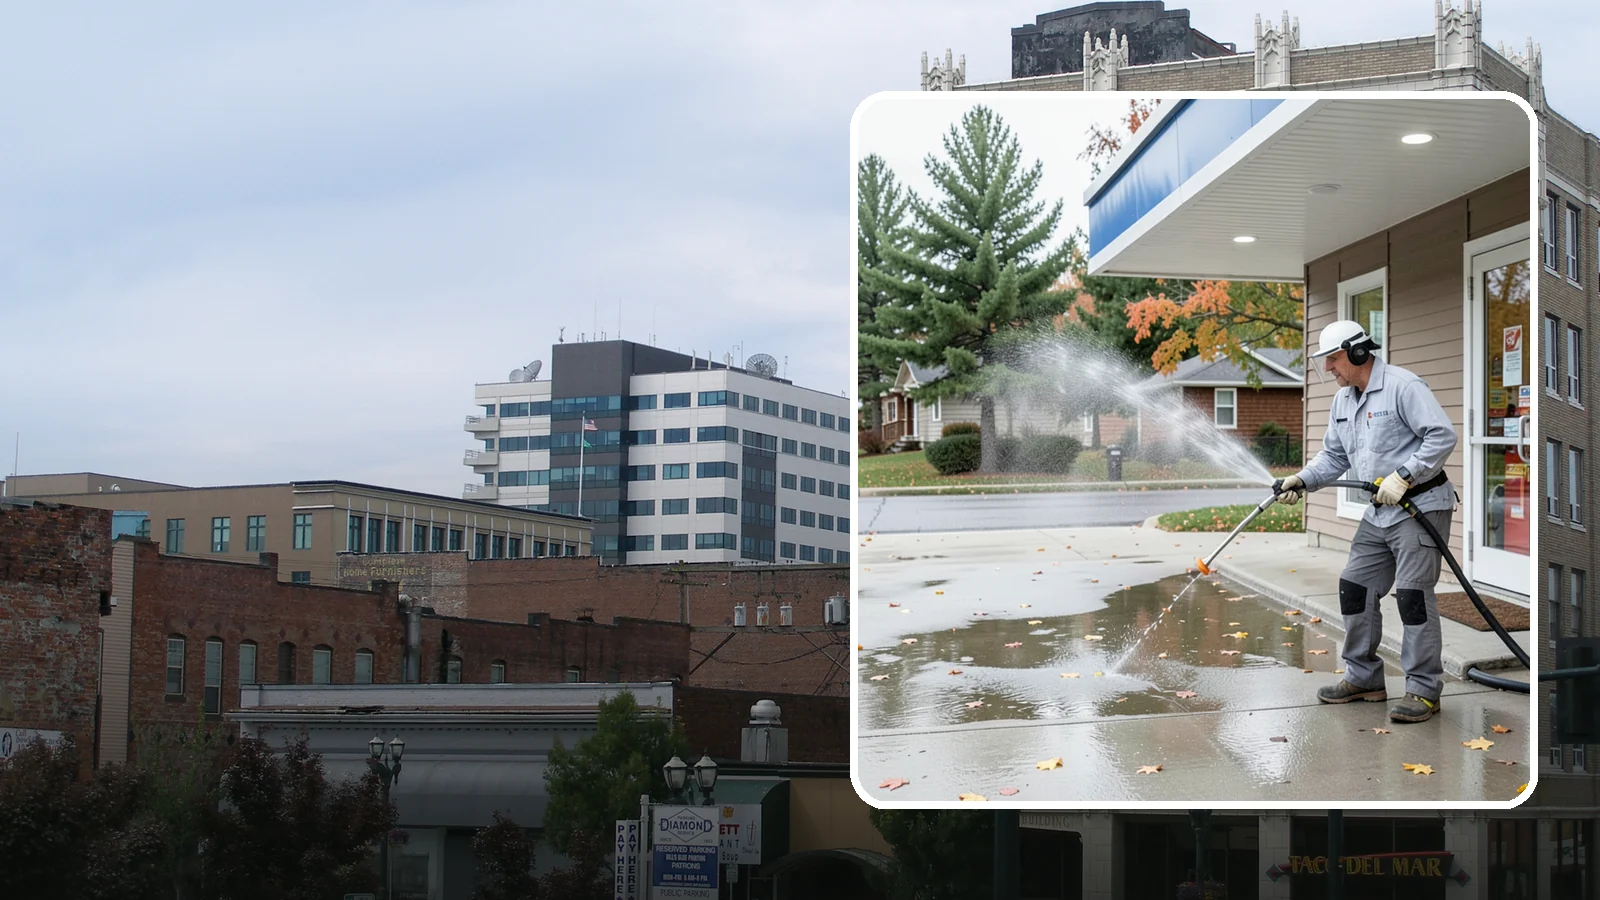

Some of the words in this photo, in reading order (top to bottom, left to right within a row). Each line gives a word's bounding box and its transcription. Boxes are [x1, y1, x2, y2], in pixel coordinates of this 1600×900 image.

[343, 568, 368, 577] Home
[370, 566, 428, 577] Furnishers
[660, 817, 713, 833] DIAMOND
[1022, 815, 1070, 828] BUILDING
[617, 824, 625, 853] PAY
[628, 824, 637, 853] PAY
[655, 845, 688, 853] RESERVED
[689, 846, 716, 854] PARKING
[721, 851, 739, 862] Soup
[671, 862, 701, 870] PATRONS
[1289, 855, 1329, 874] TAC
[1345, 857, 1385, 875] DEL
[1392, 857, 1442, 876] MAR
[616, 855, 625, 894] HERE
[627, 855, 637, 894] HERE
[660, 888, 682, 897] PUBLIC
[683, 889, 710, 898] PARKING
